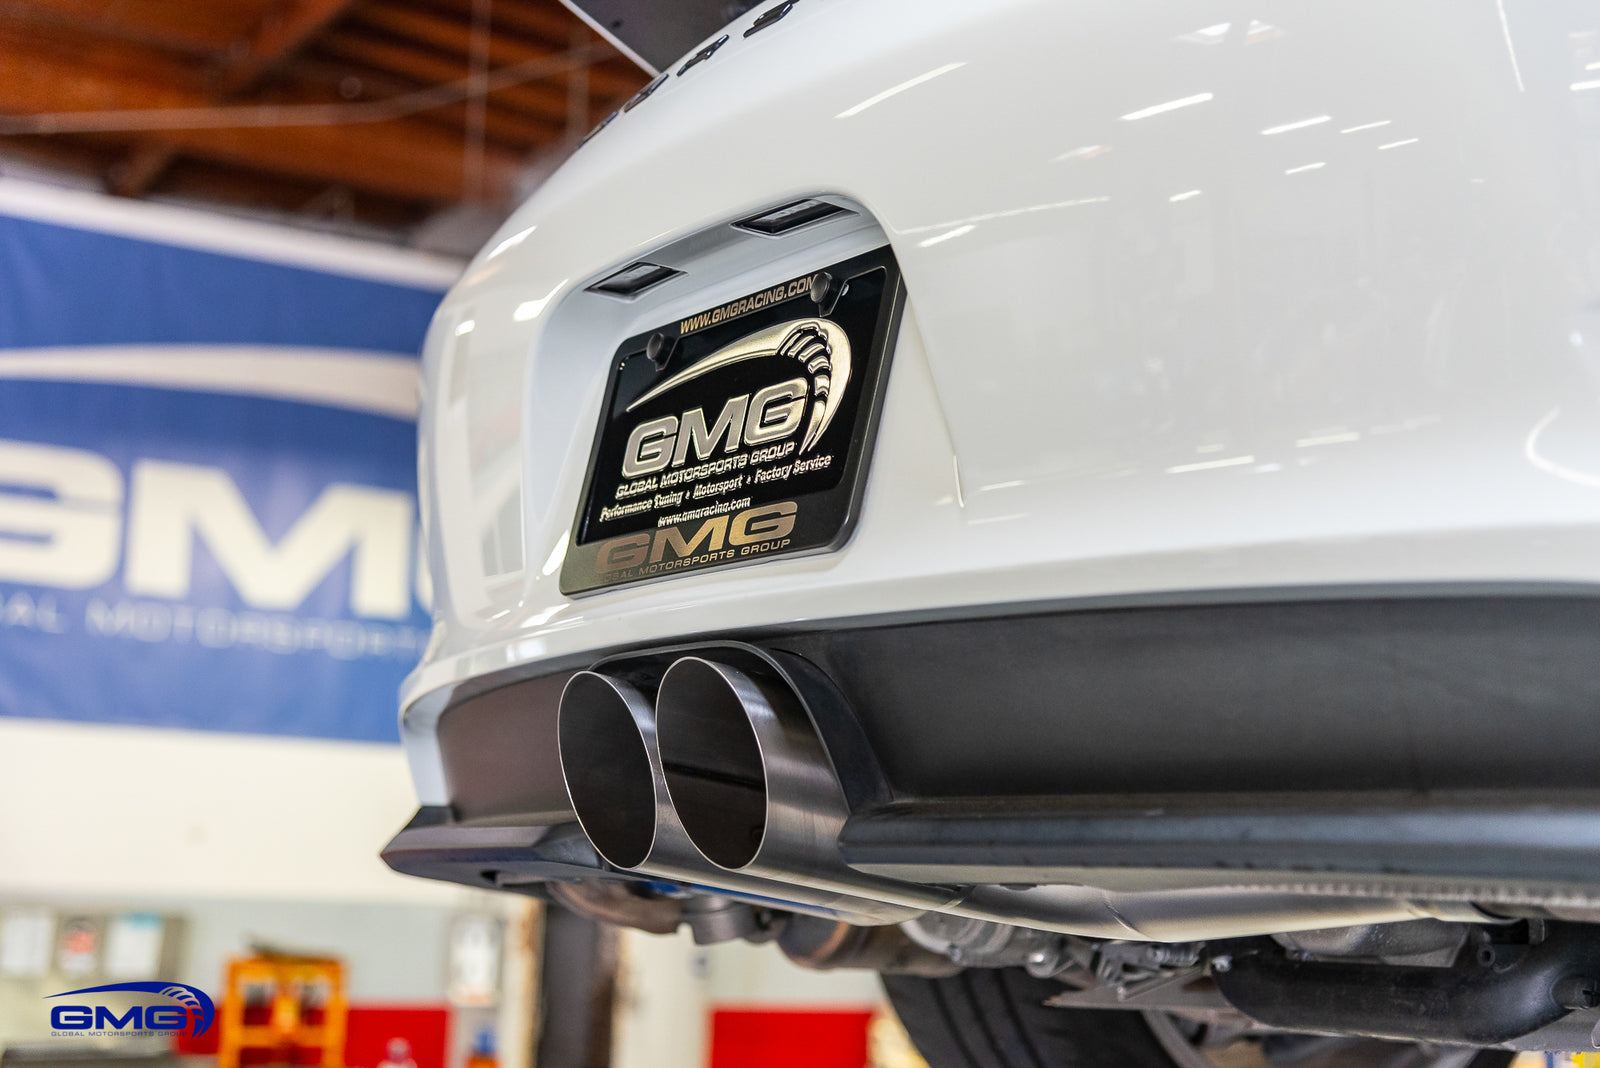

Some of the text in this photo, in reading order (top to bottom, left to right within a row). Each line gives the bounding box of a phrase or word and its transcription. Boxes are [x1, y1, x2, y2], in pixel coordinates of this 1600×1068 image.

[622, 377, 808, 479] GMG
[599, 454, 832, 522] Performance Tuning Motorsport Factory Service
[615, 441, 795, 500] GLOBAL MOTORSPORTS GROUP
[595, 501, 798, 574] GMG
[639, 549, 735, 576] MOTORSPORTS
[741, 539, 791, 555] GROUP
